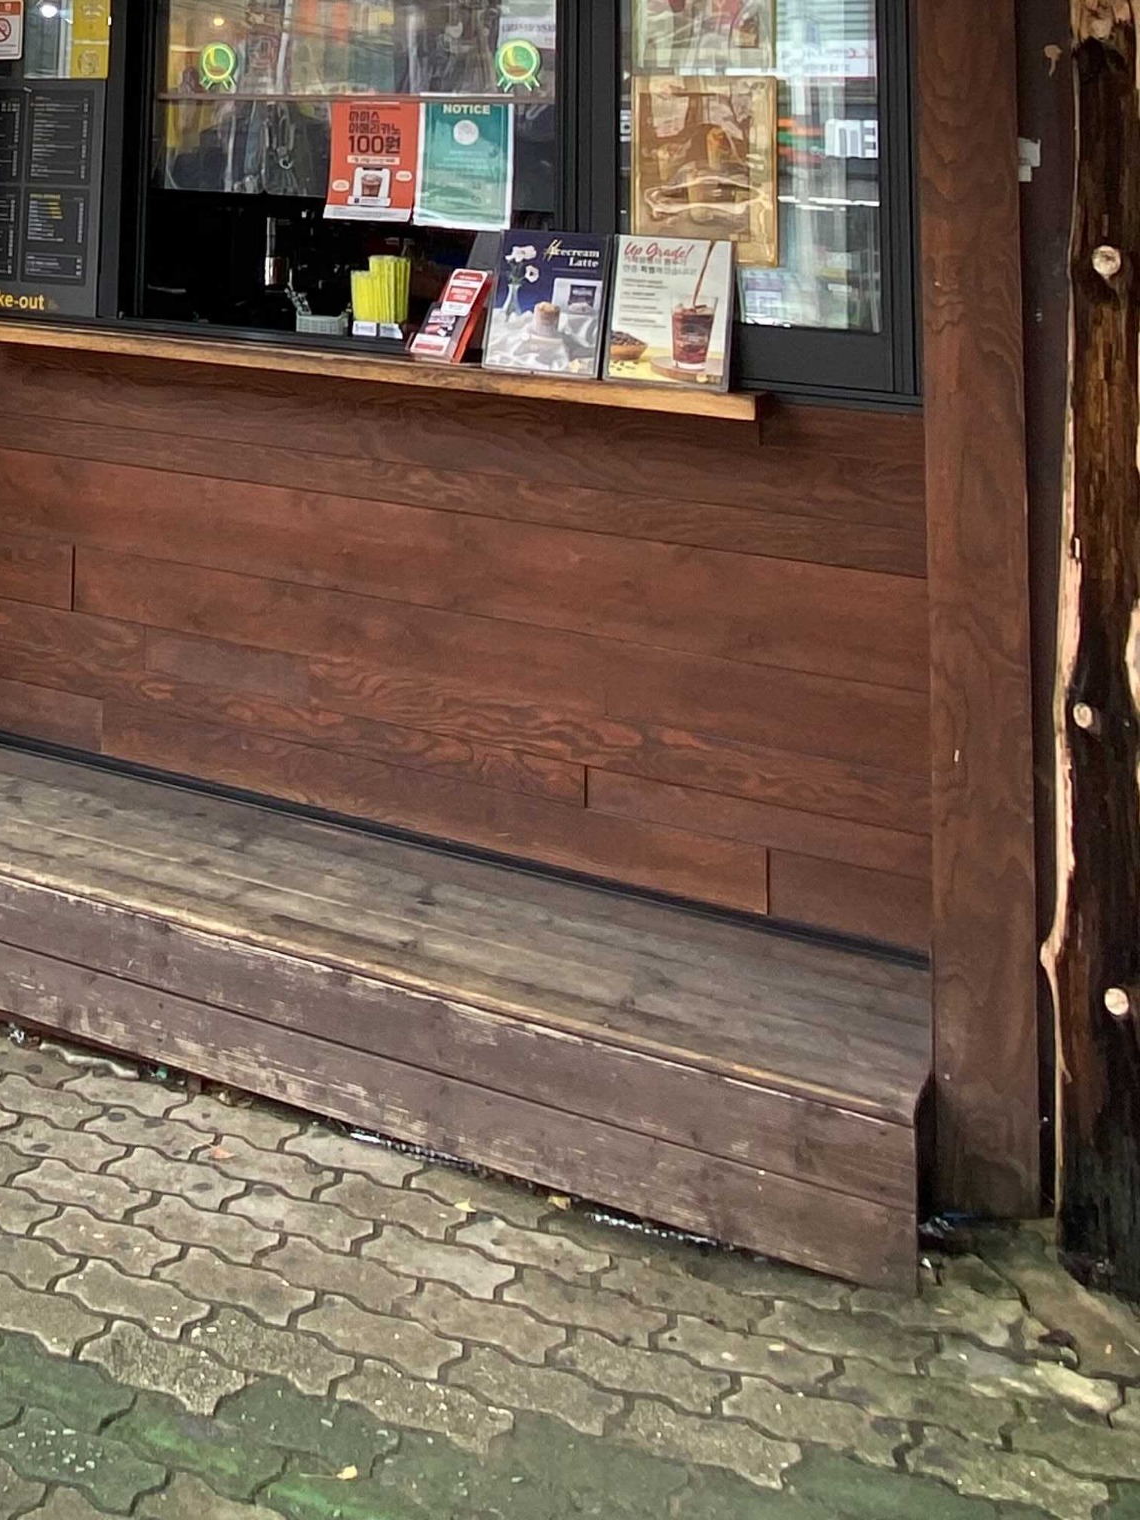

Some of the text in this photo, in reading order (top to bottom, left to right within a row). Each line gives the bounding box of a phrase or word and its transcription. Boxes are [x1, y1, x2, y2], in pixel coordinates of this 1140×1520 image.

[443, 104, 491, 115] NOTICE
[349, 123, 401, 135] 아메리카노
[348, 135, 401, 154] 100원
[624, 241, 643, 258] Up
[568, 257, 600, 268] Latte
